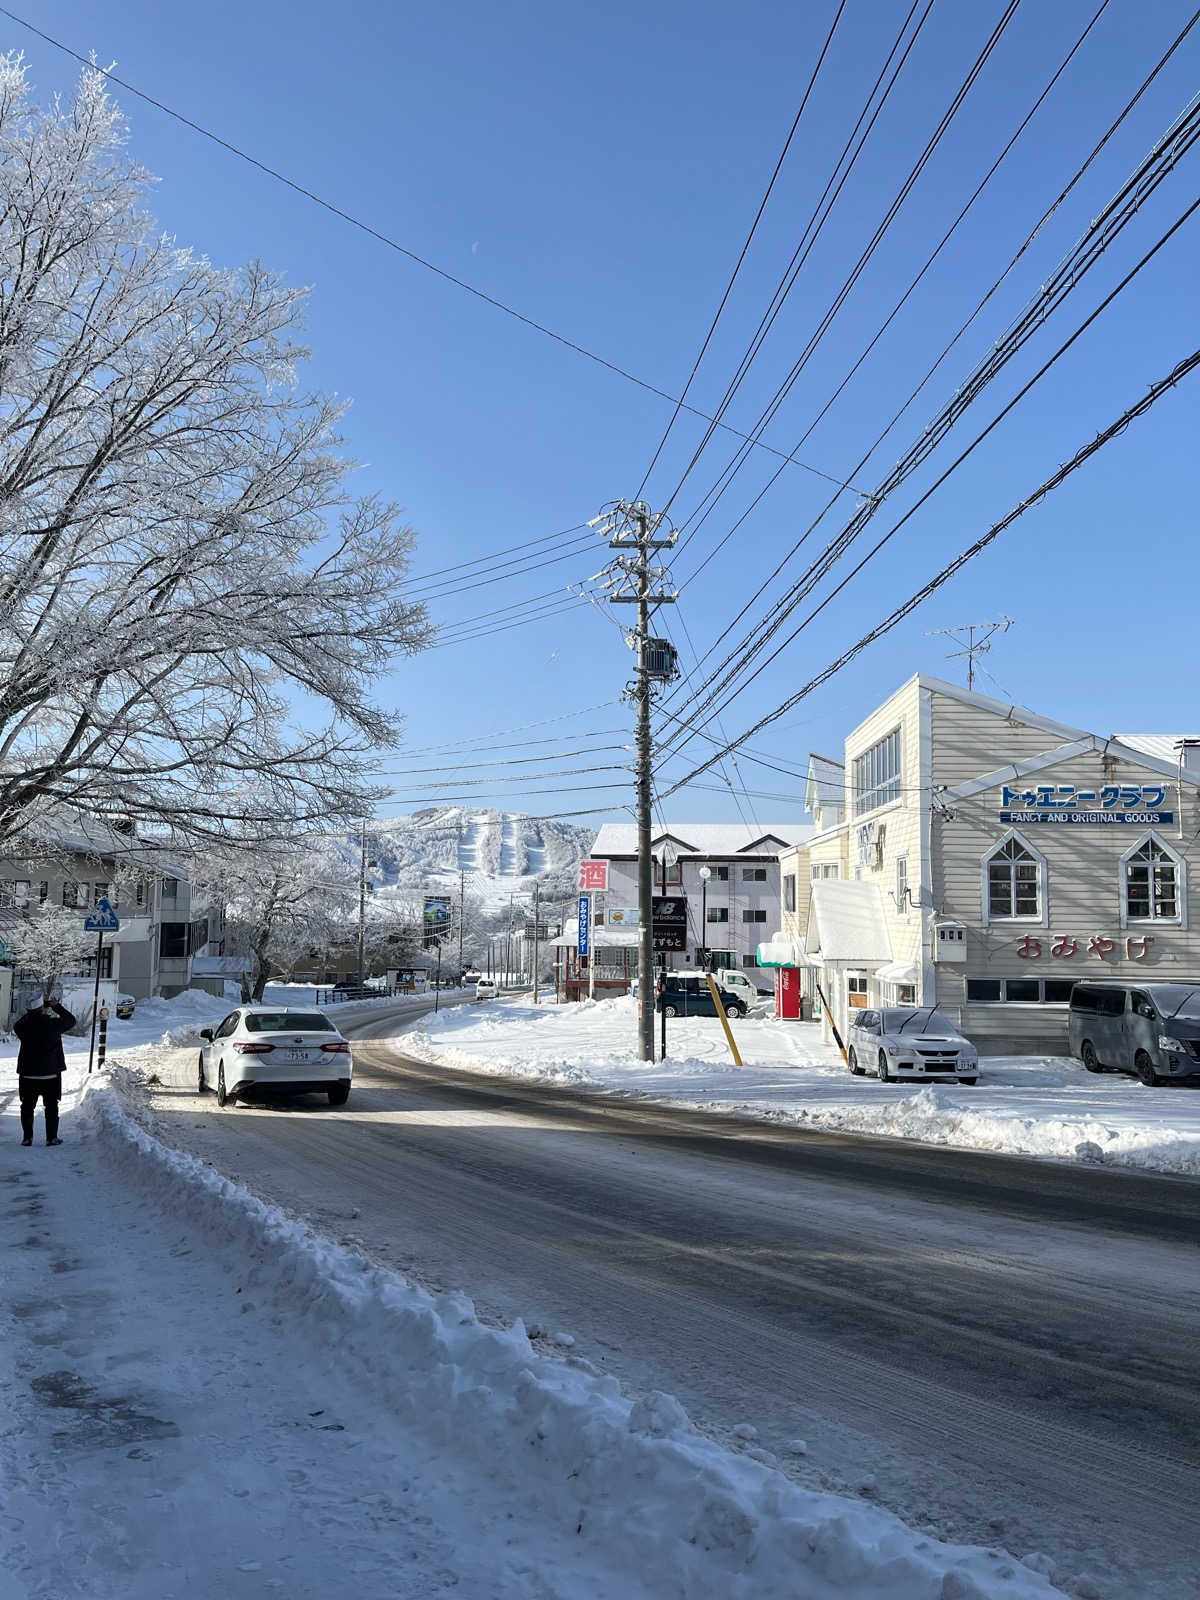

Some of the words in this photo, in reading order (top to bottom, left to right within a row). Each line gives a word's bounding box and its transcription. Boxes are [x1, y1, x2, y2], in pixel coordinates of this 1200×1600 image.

[1001, 783, 1171, 808] トゥエニークラブ
[1010, 812, 1043, 822] FANCY
[1047, 812, 1068, 823] AND
[1072, 812, 1121, 823] ORIGINAL
[1124, 813, 1160, 823] GOODS
[578, 861, 607, 890] 酒
[1016, 934, 1155, 960] おみやげ
